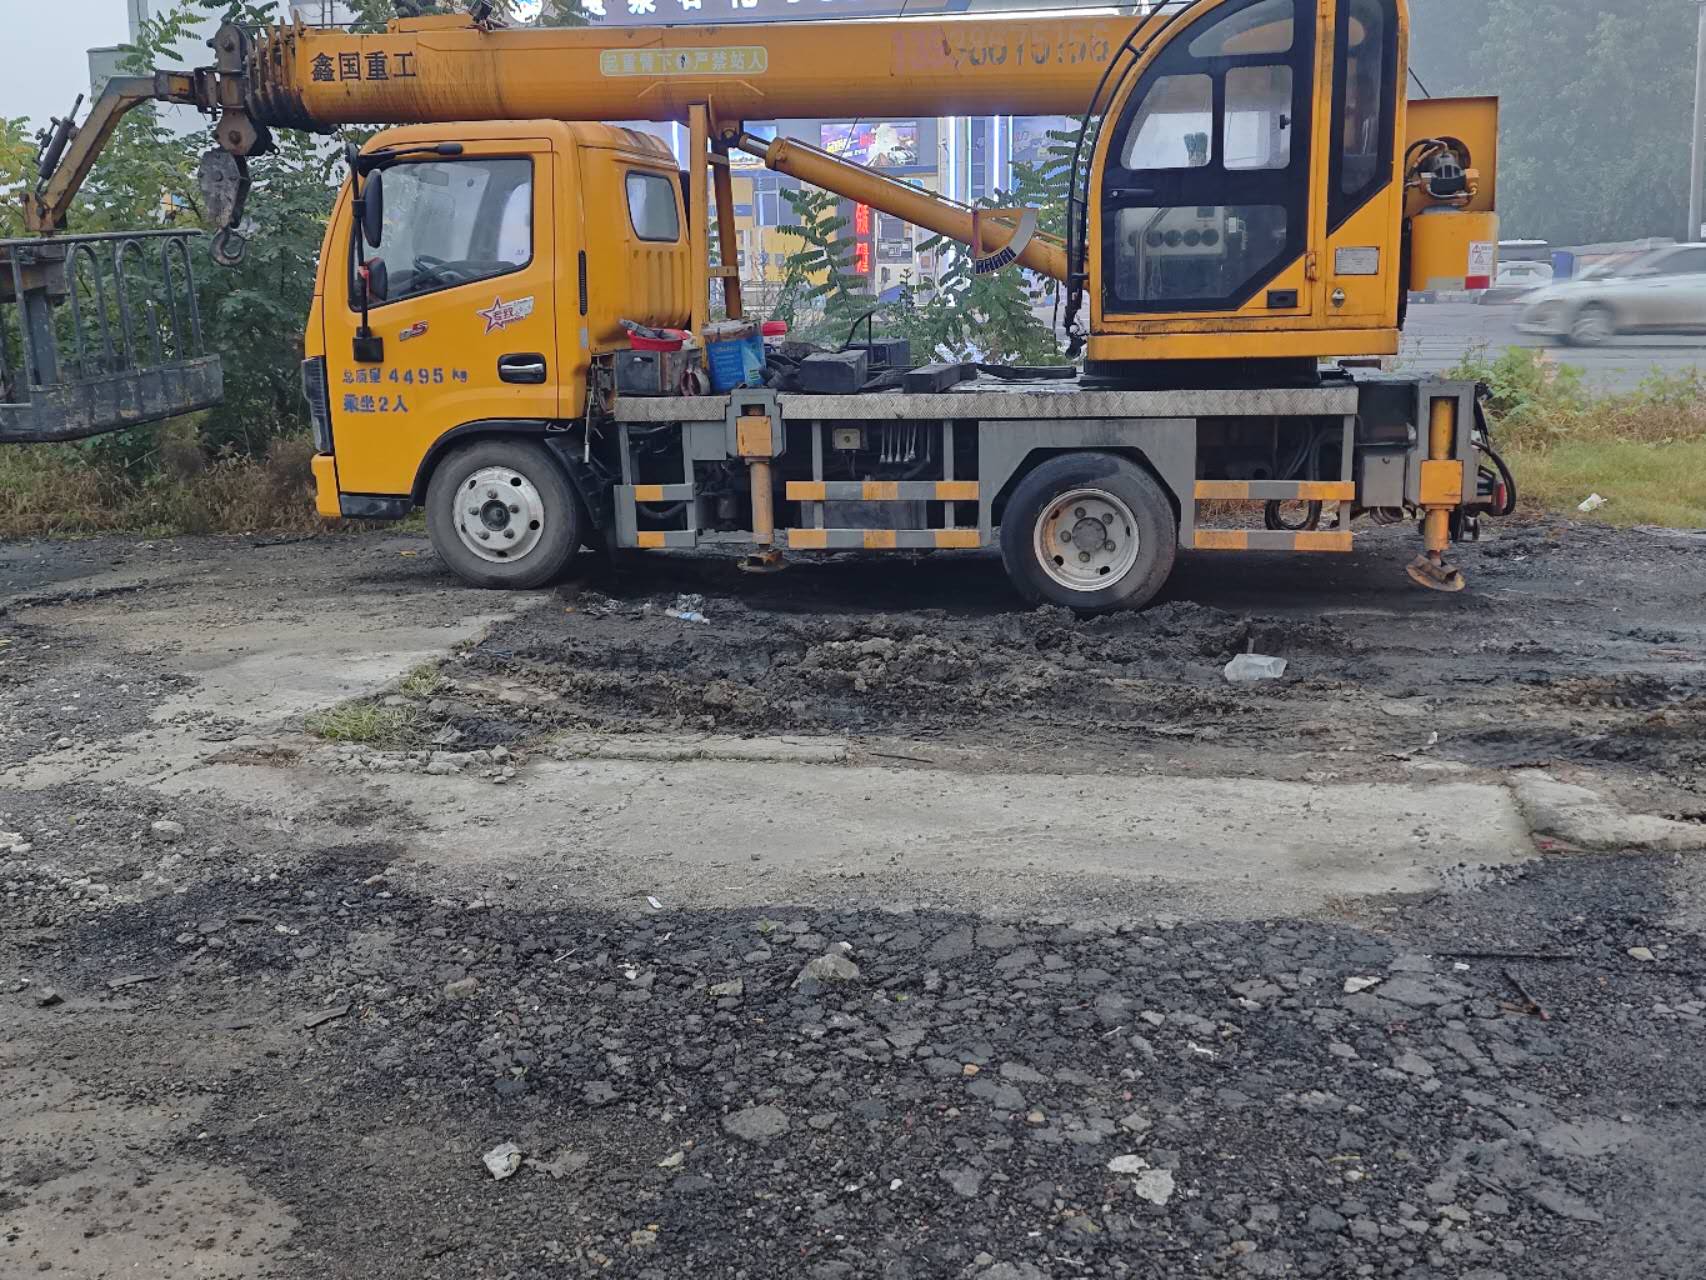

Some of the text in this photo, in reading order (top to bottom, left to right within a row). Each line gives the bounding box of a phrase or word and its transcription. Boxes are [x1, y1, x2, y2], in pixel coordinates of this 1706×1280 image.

[310, 50, 417, 82] 鑫国重工
[388, 368, 444, 384] 4495
